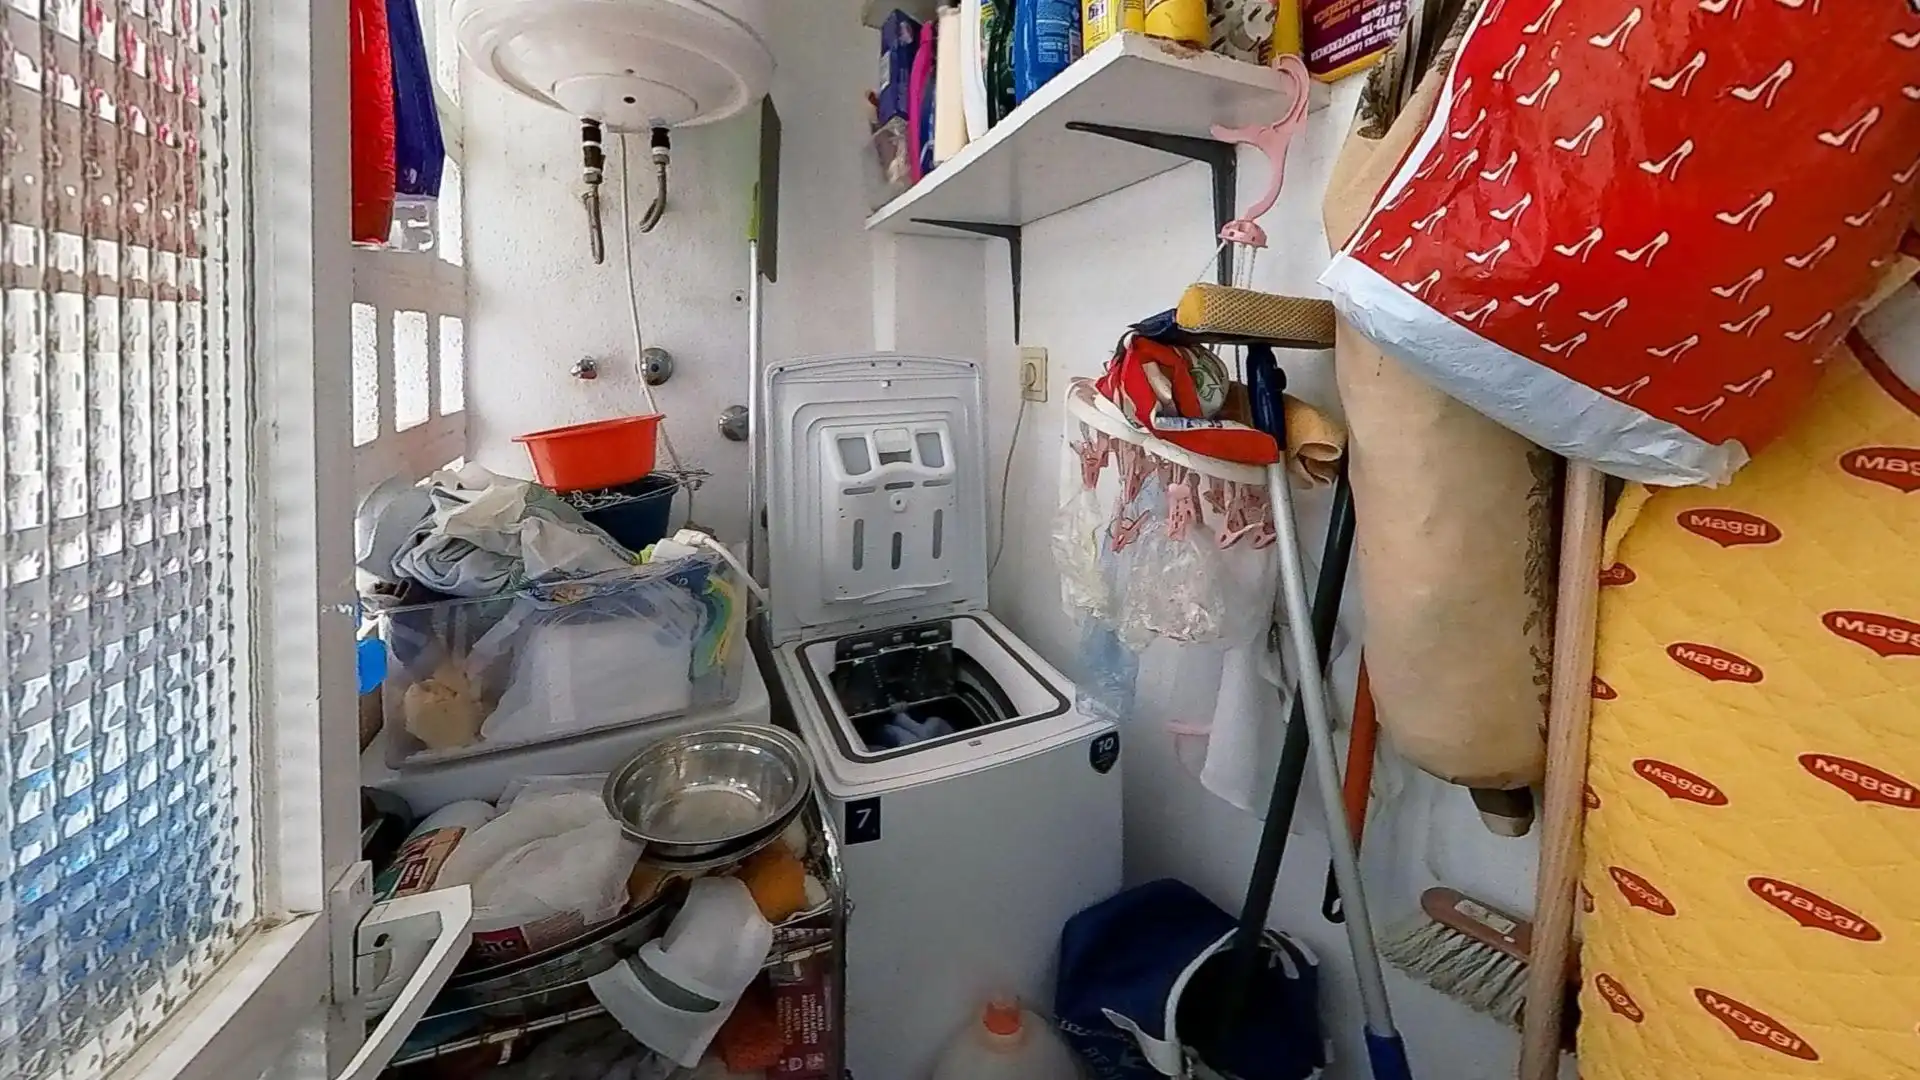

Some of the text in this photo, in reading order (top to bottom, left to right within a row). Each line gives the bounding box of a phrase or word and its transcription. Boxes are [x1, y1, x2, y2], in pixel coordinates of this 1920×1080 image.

[1855, 454, 1920, 477] Mag
[1690, 514, 1766, 537] Maggi
[1676, 646, 1752, 677] Maggi
[1644, 763, 1715, 800] Maggi
[1814, 758, 1913, 801] Maggi
[855, 808, 872, 829] 7
[1762, 882, 1865, 934] Maggi
[1705, 993, 1801, 1051] Maggi
